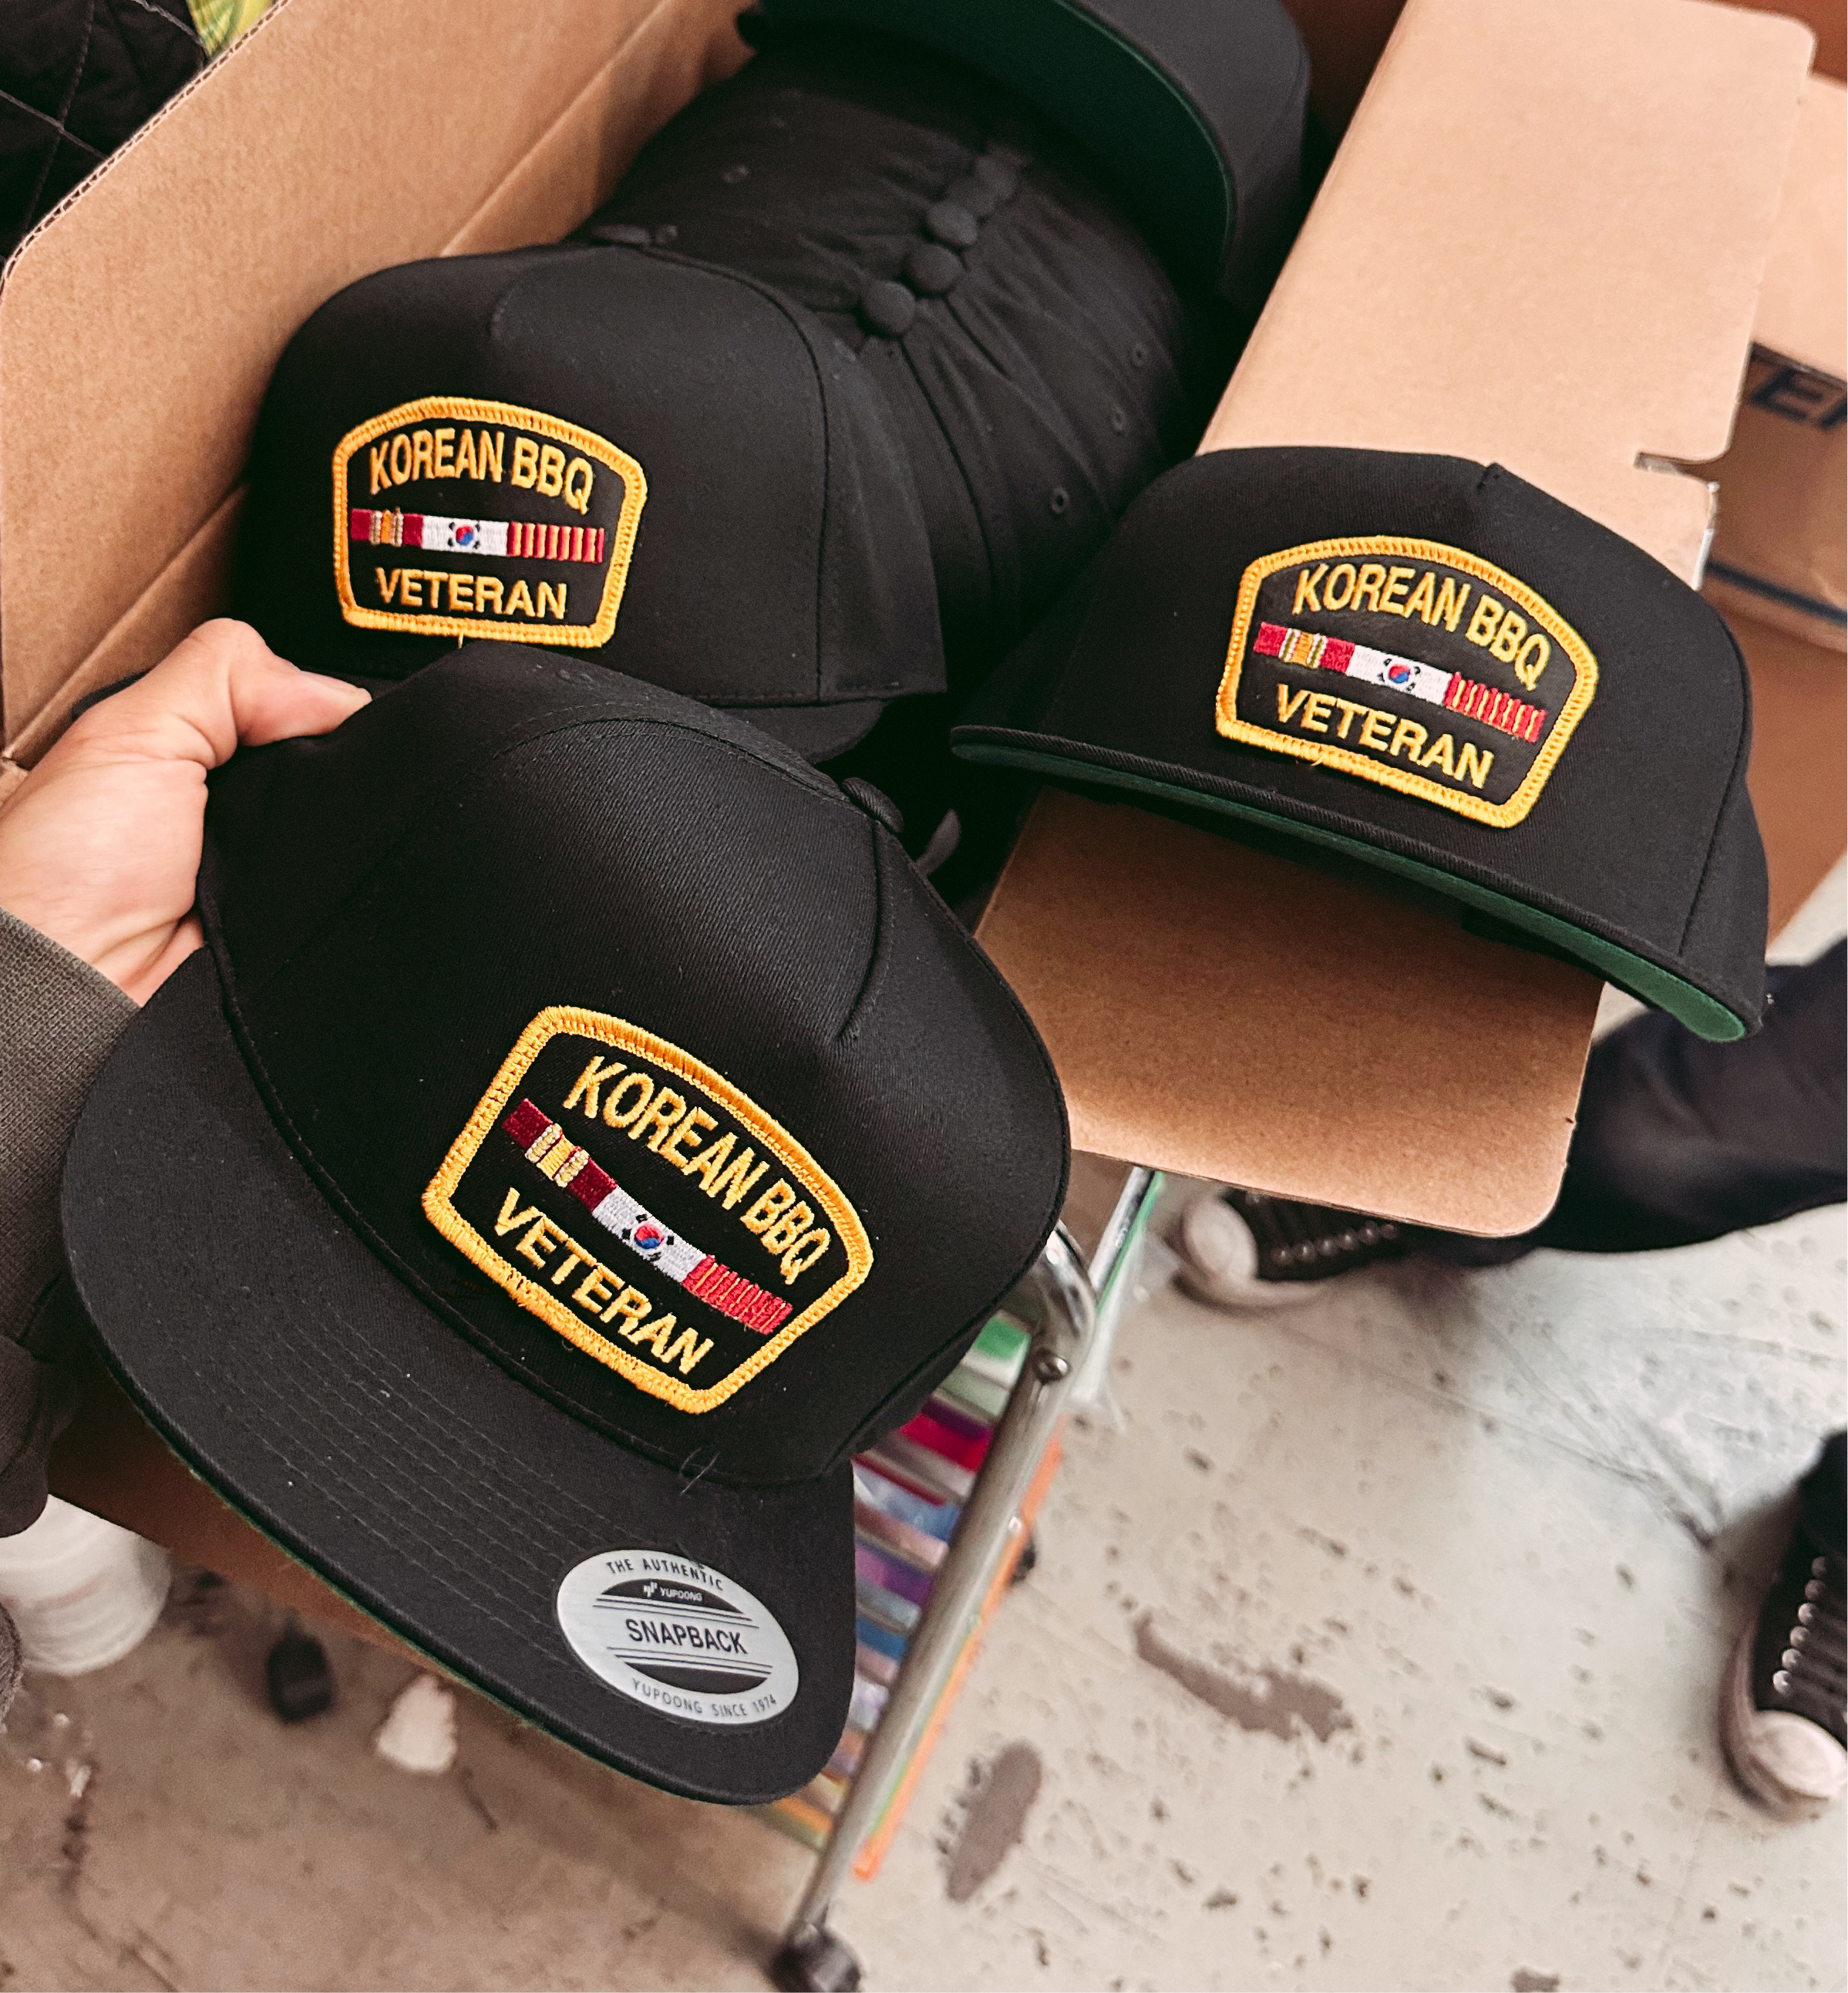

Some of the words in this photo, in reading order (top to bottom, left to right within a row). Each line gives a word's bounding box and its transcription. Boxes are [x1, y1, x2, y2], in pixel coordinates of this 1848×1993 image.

[370, 428, 504, 495] KOREAN
[511, 436, 594, 514] BBQ
[375, 567, 567, 619] VETERAN
[1292, 563, 1470, 632] KOREAN
[1466, 594, 1551, 692] BBQ
[1277, 684, 1495, 789] VETERAN
[563, 1055, 769, 1210] KOREAN
[739, 1178, 831, 1285] BBQ
[494, 1187, 714, 1375] VETERAN
[606, 1558, 634, 1574] THE
[642, 1558, 723, 1591] AUTHENTIC
[659, 1587, 703, 1602] YUPOONG
[625, 1618, 748, 1655] SNAPBACK
[631, 1677, 702, 1714] YUPOONG
[711, 1703, 748, 1717] SINCE
[752, 1694, 776, 1713] 1974
